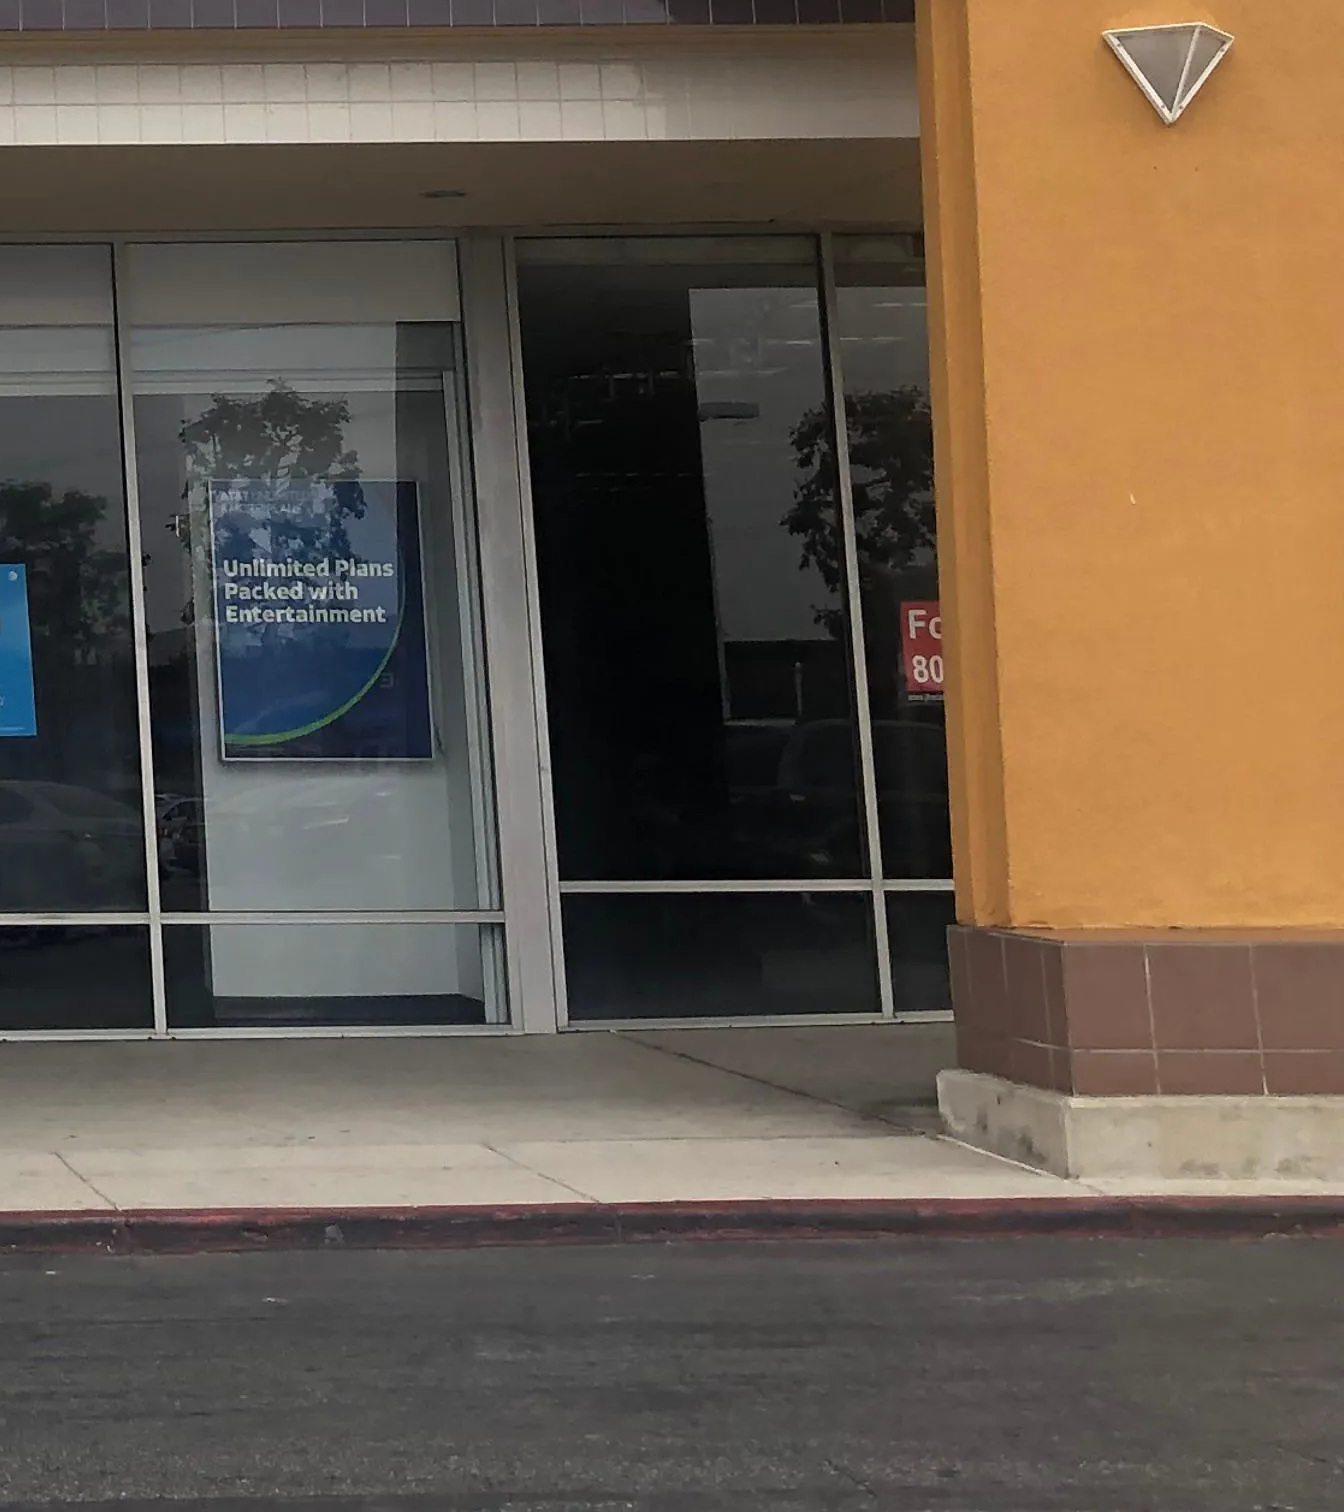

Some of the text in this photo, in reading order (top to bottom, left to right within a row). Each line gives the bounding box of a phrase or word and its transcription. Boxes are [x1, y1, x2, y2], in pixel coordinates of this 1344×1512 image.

[223, 558, 395, 577] Unlimited Plans
[224, 581, 359, 600] Packed with
[226, 604, 387, 623] Entertainment
